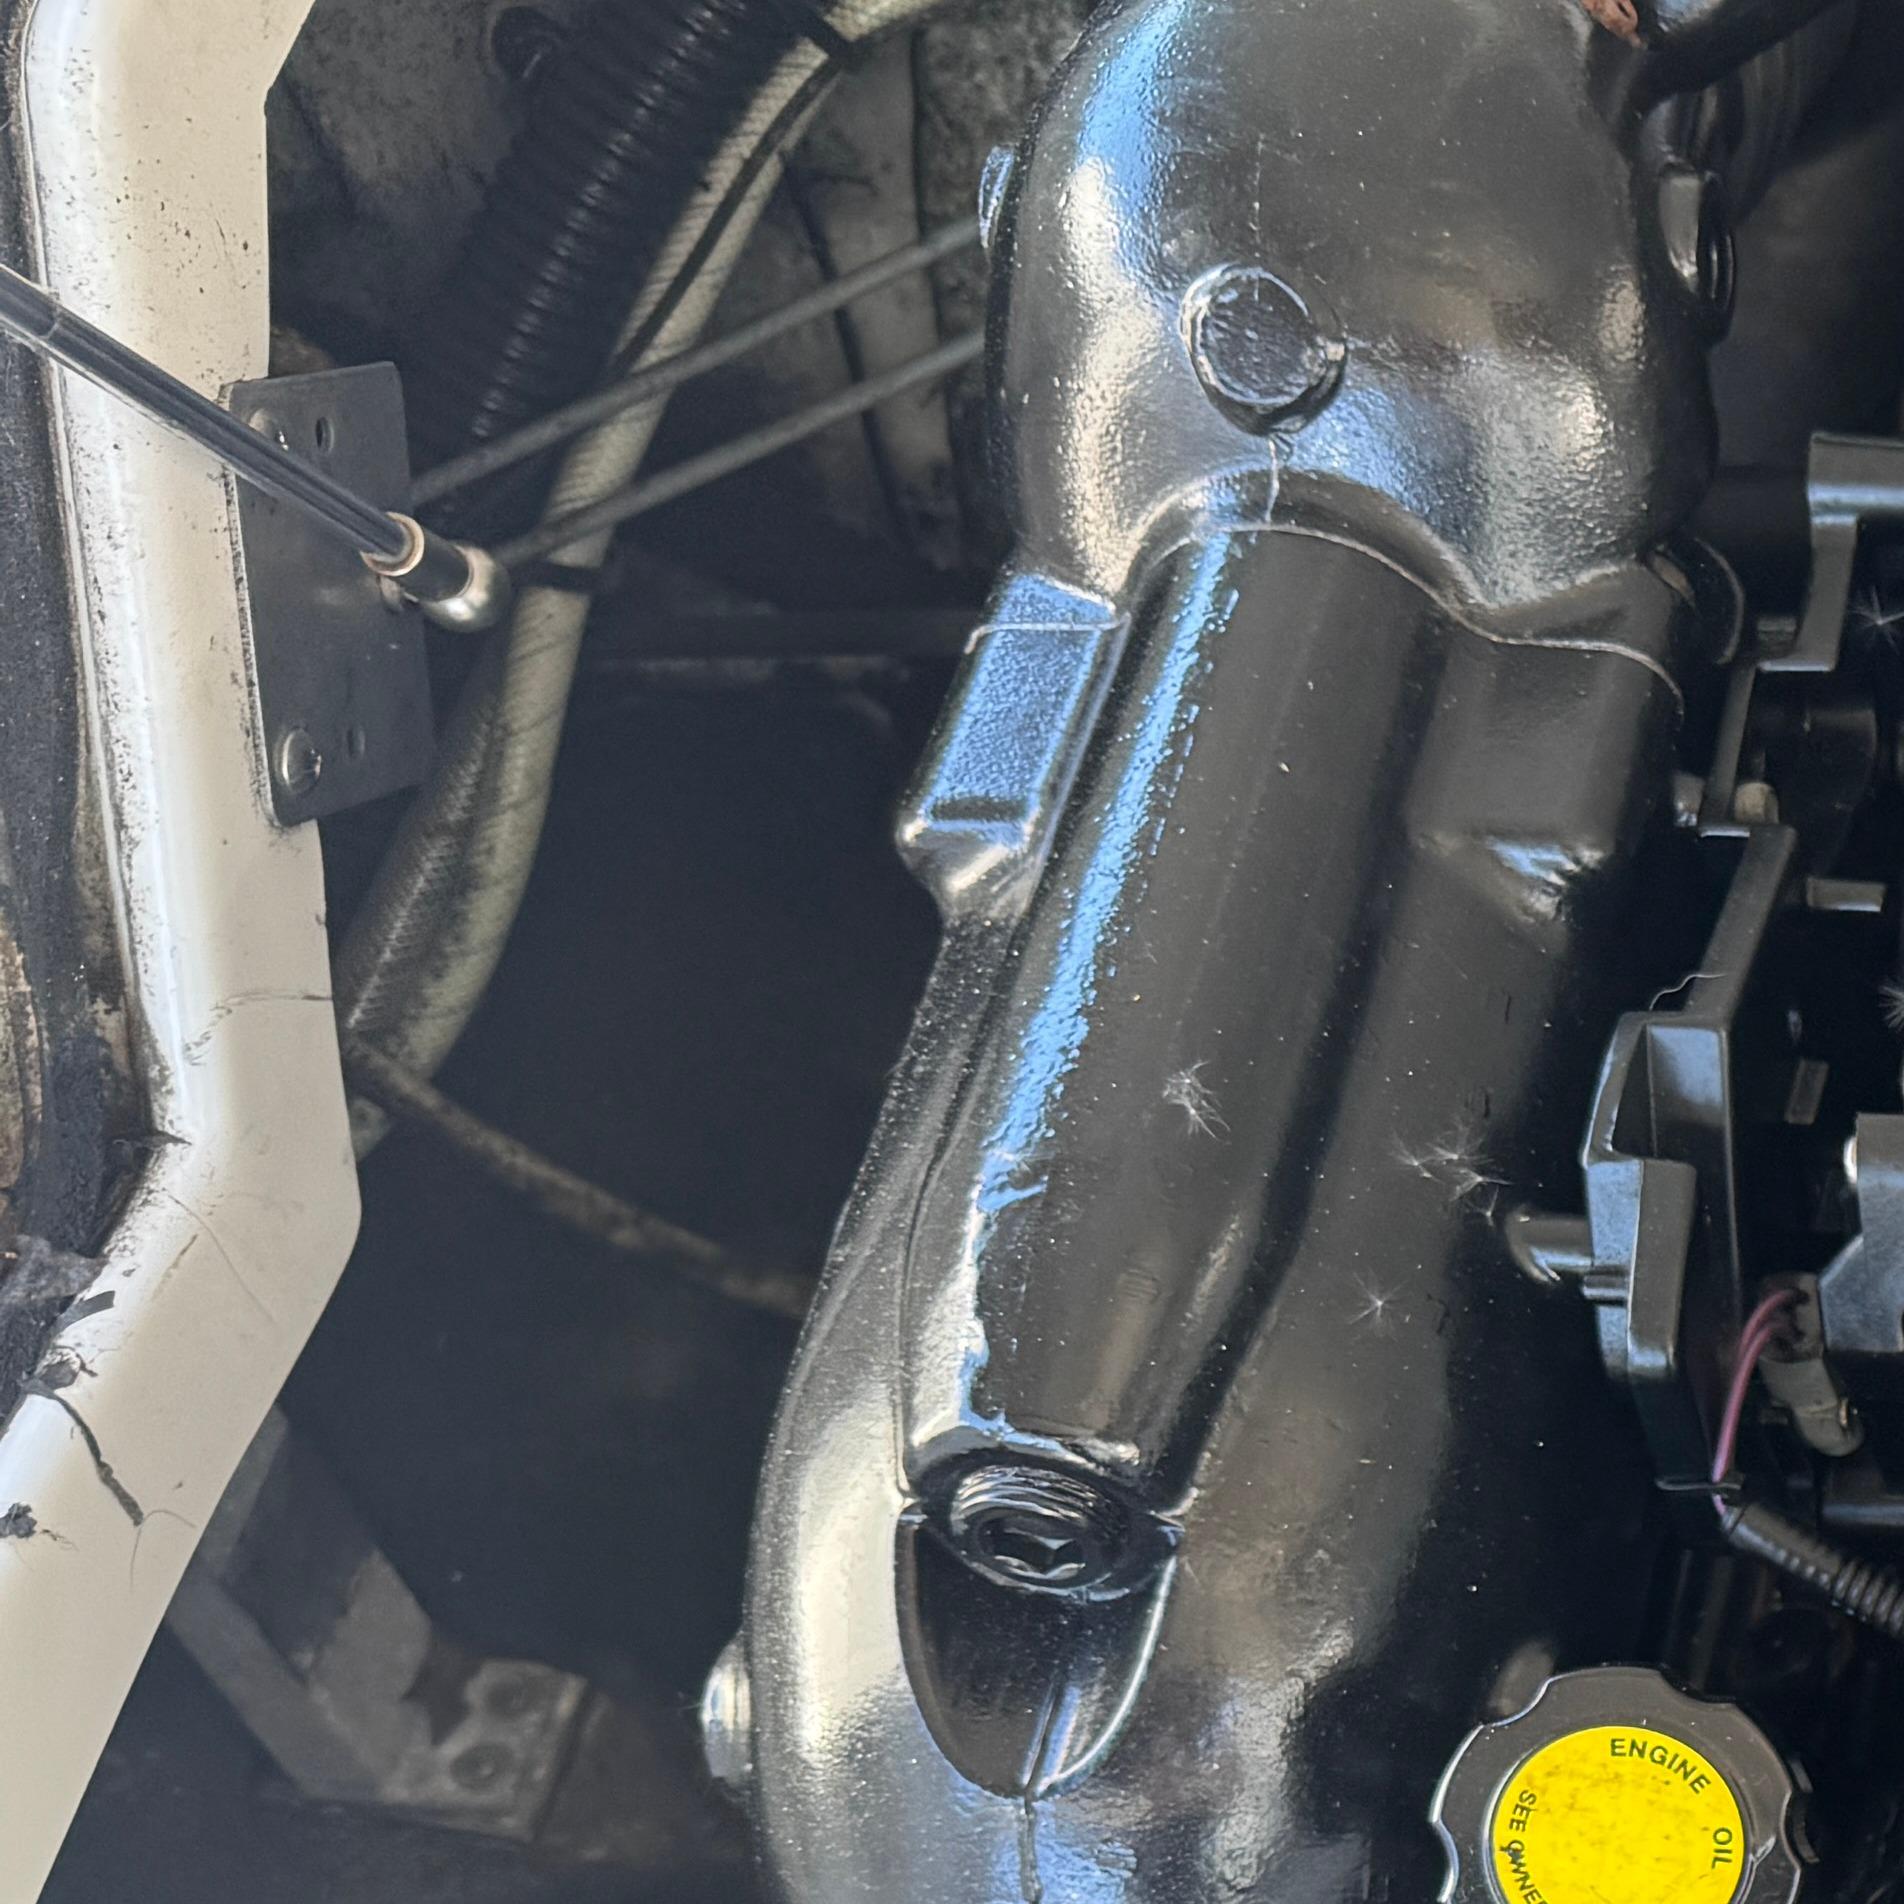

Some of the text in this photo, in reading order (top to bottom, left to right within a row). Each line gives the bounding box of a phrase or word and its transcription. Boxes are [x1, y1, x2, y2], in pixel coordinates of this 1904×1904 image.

[1508, 1788, 1537, 1832] SEE
[1610, 1737, 1733, 1870] ENGINE OIL
